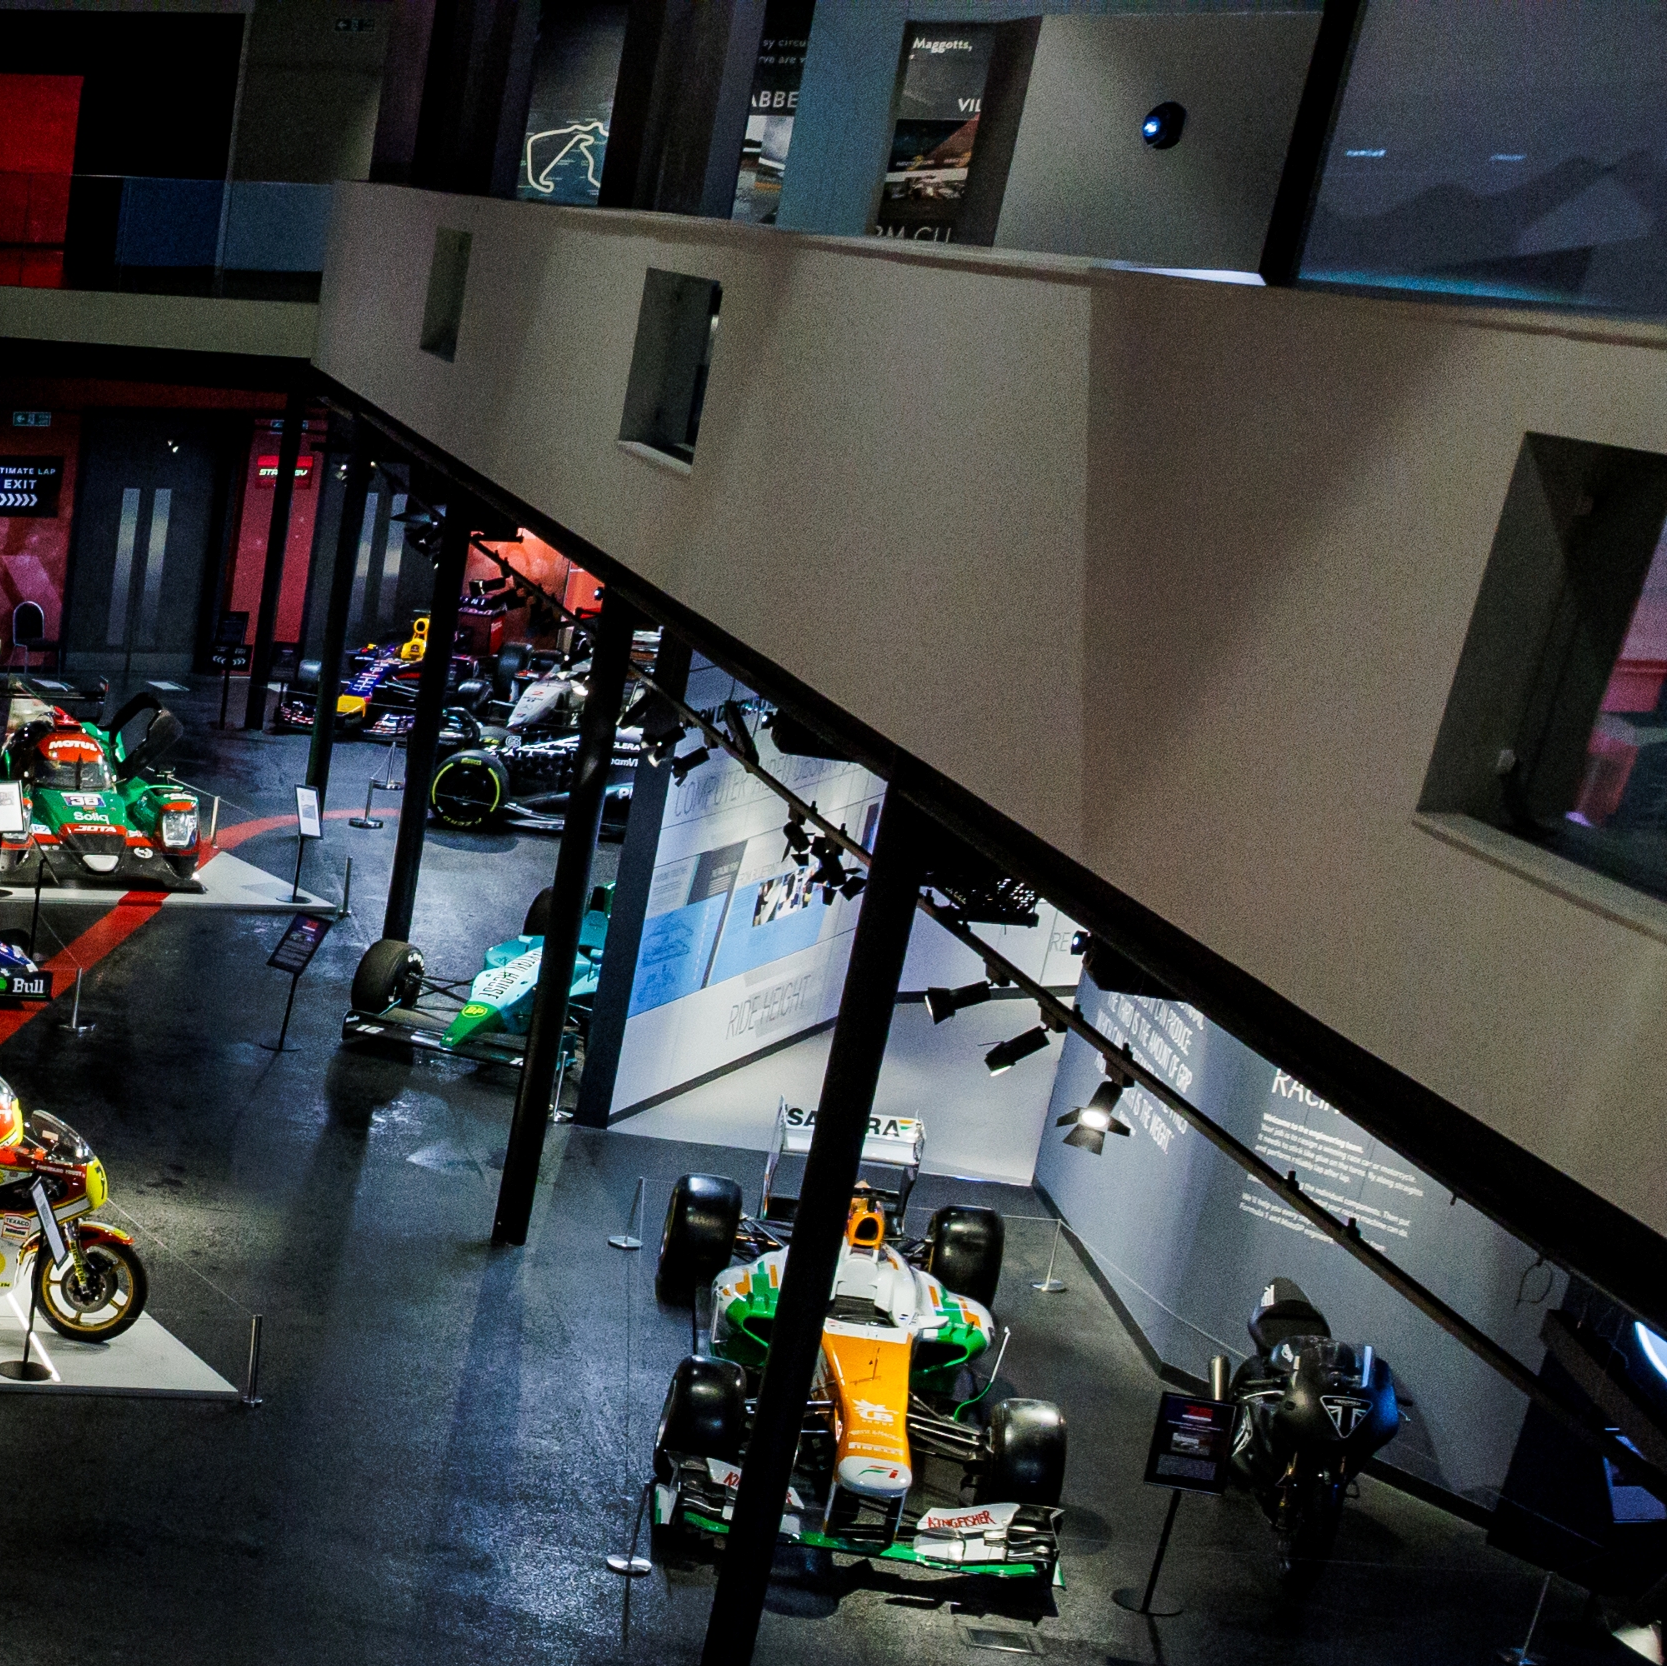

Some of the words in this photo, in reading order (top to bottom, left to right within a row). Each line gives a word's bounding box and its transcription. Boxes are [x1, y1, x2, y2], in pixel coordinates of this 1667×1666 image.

[913, 37, 972, 53] Maggotts,
[751, 91, 798, 108] ABBE
[37, 467, 56, 476] LAP
[3, 479, 37, 490] EXIT
[49, 739, 98, 752] MOTUL
[70, 795, 98, 806] 38
[674, 770, 750, 817] COMPUTER
[74, 825, 117, 834] JOTA
[12, 977, 45, 995] Bull
[463, 1005, 486, 1016] BP
[725, 994, 760, 1040] RIDE
[762, 974, 812, 1023] HEIGHT
[1147, 1030, 1173, 1071] AMOUNT
[1169, 1054, 1180, 1080] OF
[1175, 1063, 1193, 1093] GRIP
[786, 1106, 901, 1138] SARA
[1263, 1112, 1291, 1129] Welcome
[5, 1216, 30, 1228] TEXACO
[927, 1510, 997, 1529] KINGFISHER
